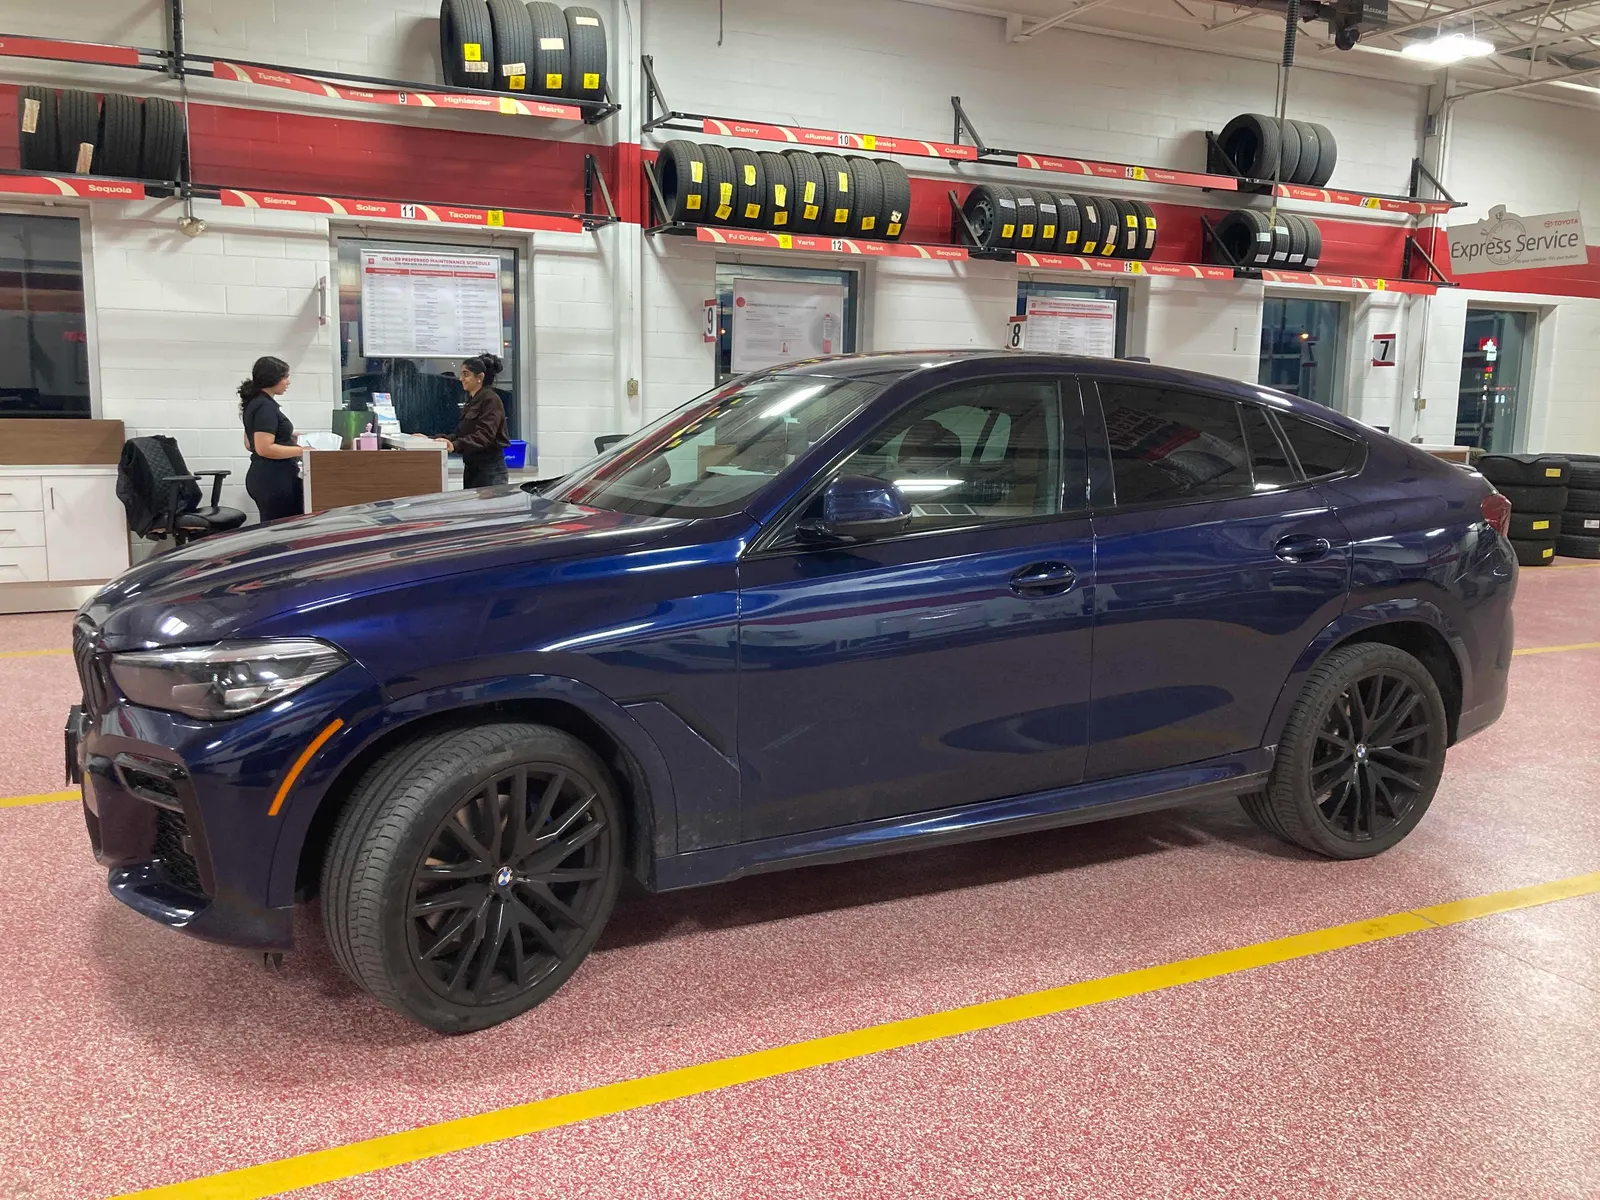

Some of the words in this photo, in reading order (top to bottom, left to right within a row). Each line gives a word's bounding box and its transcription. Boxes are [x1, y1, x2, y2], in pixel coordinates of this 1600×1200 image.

[257, 72, 291, 84] Tundra
[400, 92, 406, 103] 9
[444, 96, 491, 106] Highlander
[538, 105, 565, 114] Matrix
[735, 126, 759, 134] Camry
[804, 133, 834, 141] 4Runner
[839, 135, 849, 145] 10
[88, 184, 132, 194] Sequoia
[263, 196, 297, 206] Sienna
[356, 204, 386, 212] Solara
[402, 205, 414, 217] 11
[448, 211, 482, 220] Tacoma
[739, 234, 765, 242] Cruiser
[832, 240, 842, 251] 12
[1451, 240, 1512, 261] Express
[1516, 230, 1579, 252] Service
[1152, 265, 1180, 273] Highlander
[707, 307, 714, 335] 9
[1012, 323, 1021, 347] 8
[1380, 340, 1390, 361] 7
